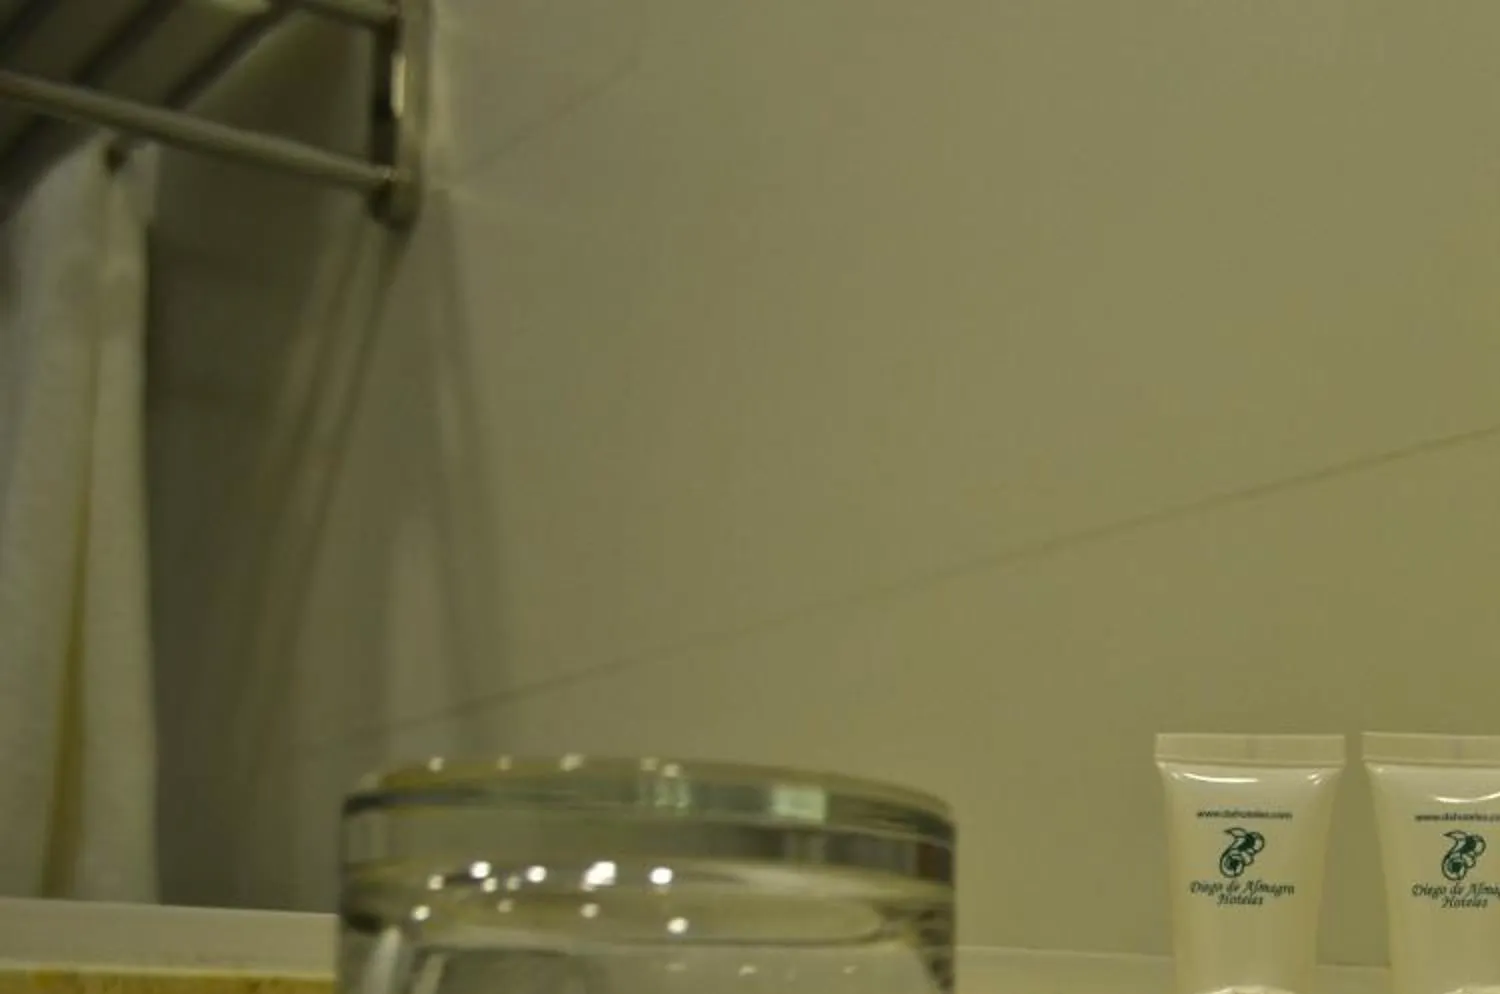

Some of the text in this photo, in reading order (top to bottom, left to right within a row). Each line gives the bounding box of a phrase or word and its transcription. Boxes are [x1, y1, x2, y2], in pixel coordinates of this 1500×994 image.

[1190, 880, 1295, 897] Diego de Almagro
[1411, 882, 1447, 899] Diego
[1450, 883, 1465, 896] de
[1217, 893, 1264, 906] Hoteles
[1441, 896, 1488, 909] Hoteles
